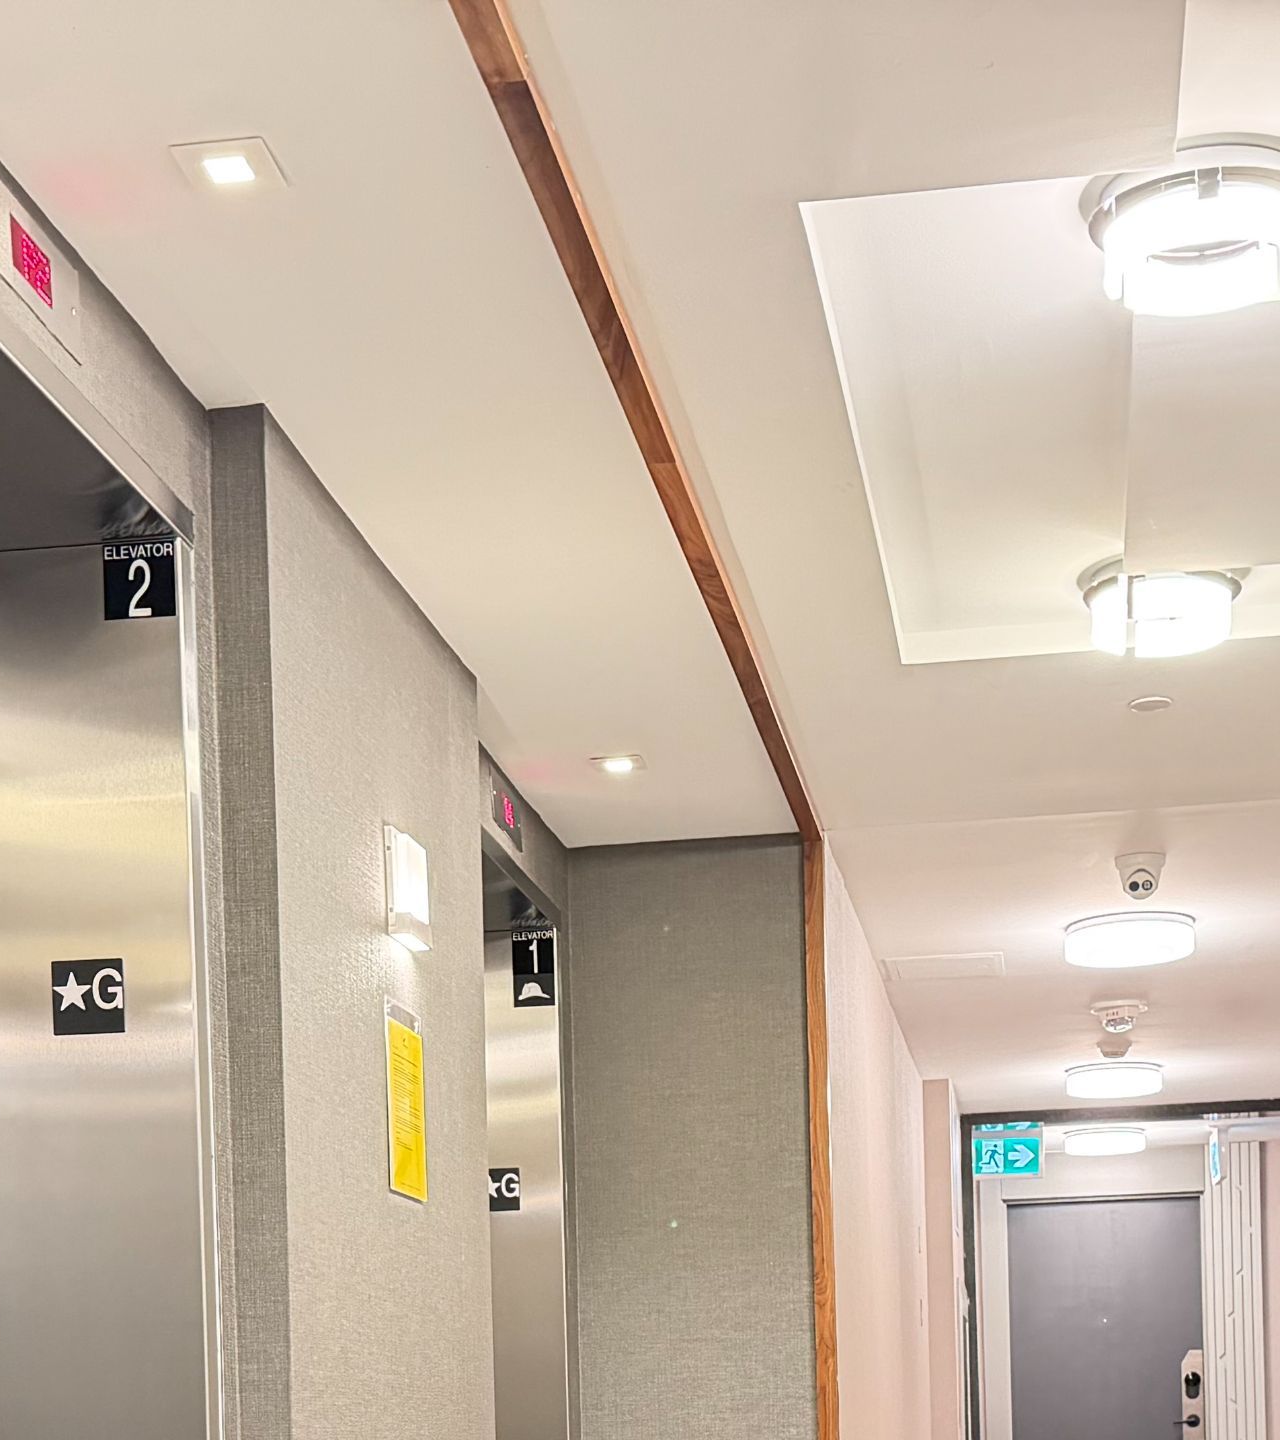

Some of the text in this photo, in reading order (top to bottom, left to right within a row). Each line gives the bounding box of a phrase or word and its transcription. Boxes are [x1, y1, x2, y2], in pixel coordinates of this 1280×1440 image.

[103, 542, 174, 560] ELEVATOR
[128, 558, 152, 618] 2
[512, 930, 554, 941] ELEVATOR
[528, 939, 538, 974] 1
[91, 967, 124, 1011] G
